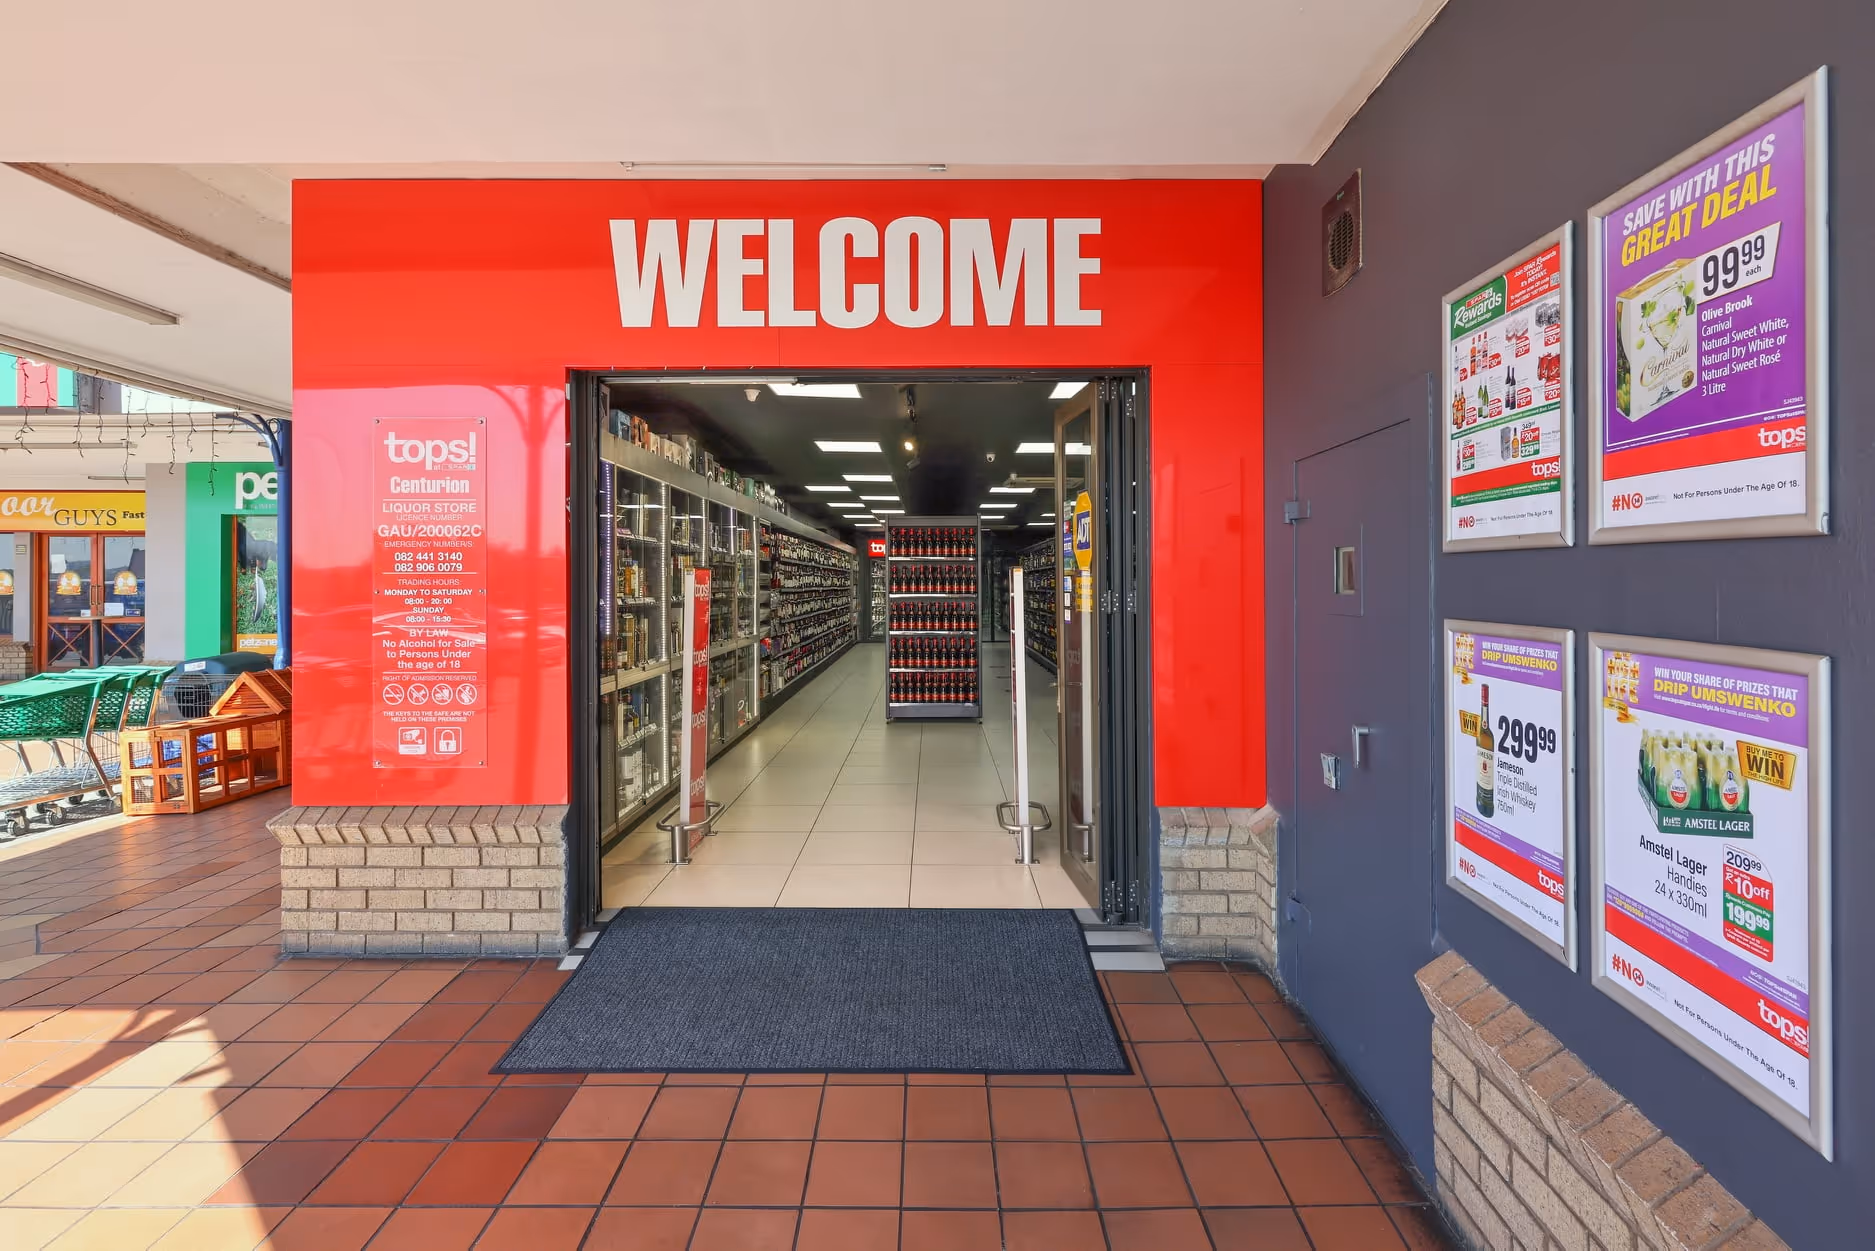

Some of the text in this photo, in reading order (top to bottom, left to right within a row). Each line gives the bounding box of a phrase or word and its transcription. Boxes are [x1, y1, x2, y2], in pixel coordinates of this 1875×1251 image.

[1622, 133, 1776, 236] SAVE WITH THIS
[1621, 163, 1777, 268] GREAT DEAL
[608, 216, 1102, 329] WELCOME
[1745, 264, 1762, 277] each
[1454, 292, 1502, 328] Rewards
[1701, 295, 1753, 322] Olive Brook
[1701, 317, 1732, 337] Carnival
[1701, 317, 1789, 352] Natural Sweet White,
[1701, 334, 1787, 367] Natural Dry White or
[1701, 366, 1730, 382] Natural
[1732, 358, 1757, 375] Sweet
[1760, 349, 1781, 367] Rosé
[1701, 381, 1726, 397] 3 Litre
[384, 432, 476, 470] tops!
[391, 476, 470, 493] Centurion
[1673, 492, 1684, 500] Not
[1685, 491, 1695, 499] For
[1695, 488, 1722, 497] Persons
[1724, 485, 1744, 495] Under
[1746, 484, 1760, 492] The
[1761, 482, 1775, 491] Age
[1777, 481, 1786, 489] Of
[54, 509, 117, 526] GUYS
[122, 511, 145, 519] Fast
[382, 503, 476, 513] LIQUOR STORE
[378, 524, 482, 537] GAU/200062C
[1076, 516, 1090, 545] ADT
[394, 552, 463, 561] 082 441 3140
[394, 563, 463, 572] 082 906 0079
[409, 629, 448, 637] BY LAW
[382, 640, 476, 648] No Alcohol for Sale
[387, 650, 472, 658] to Persons Under
[1503, 643, 1519, 654] SHARE
[1526, 647, 1544, 658] PRIZES
[1544, 650, 1559, 660] THAT
[397, 660, 461, 670] the age of 18
[1481, 650, 1501, 661] DRIP
[1502, 653, 1558, 672] UMSWENKO
[1654, 666, 1799, 701] WIN YOUR SHARE OF PRIZES THAT
[1653, 679, 1797, 718] DRIP UMSWENKO
[1463, 717, 1478, 732] WIN
[1746, 746, 1784, 761] BUY ME TO
[1497, 757, 1524, 777] Jameson
[1746, 753, 1784, 780] WIN
[1497, 771, 1538, 797] Triple Distilled
[1759, 773, 1772, 782] HIGH
[1497, 786, 1537, 813] Irish Whiskey
[1497, 799, 1515, 816] 750ml
[1684, 818, 1718, 830] AMSTEL
[1719, 820, 1750, 832] LAGER
[1639, 835, 1708, 876] Amstel Lager
[1667, 865, 1708, 898] Handies
[1654, 879, 1708, 918] 24 x 330ml
[1674, 999, 1685, 1011] Not
[1685, 1006, 1695, 1018] For
[1696, 1014, 1722, 1037] Persons
[1724, 1032, 1744, 1051] Under
[1745, 1047, 1759, 1062] The
[1760, 1058, 1775, 1074] Age
[1776, 1068, 1786, 1081] Of
